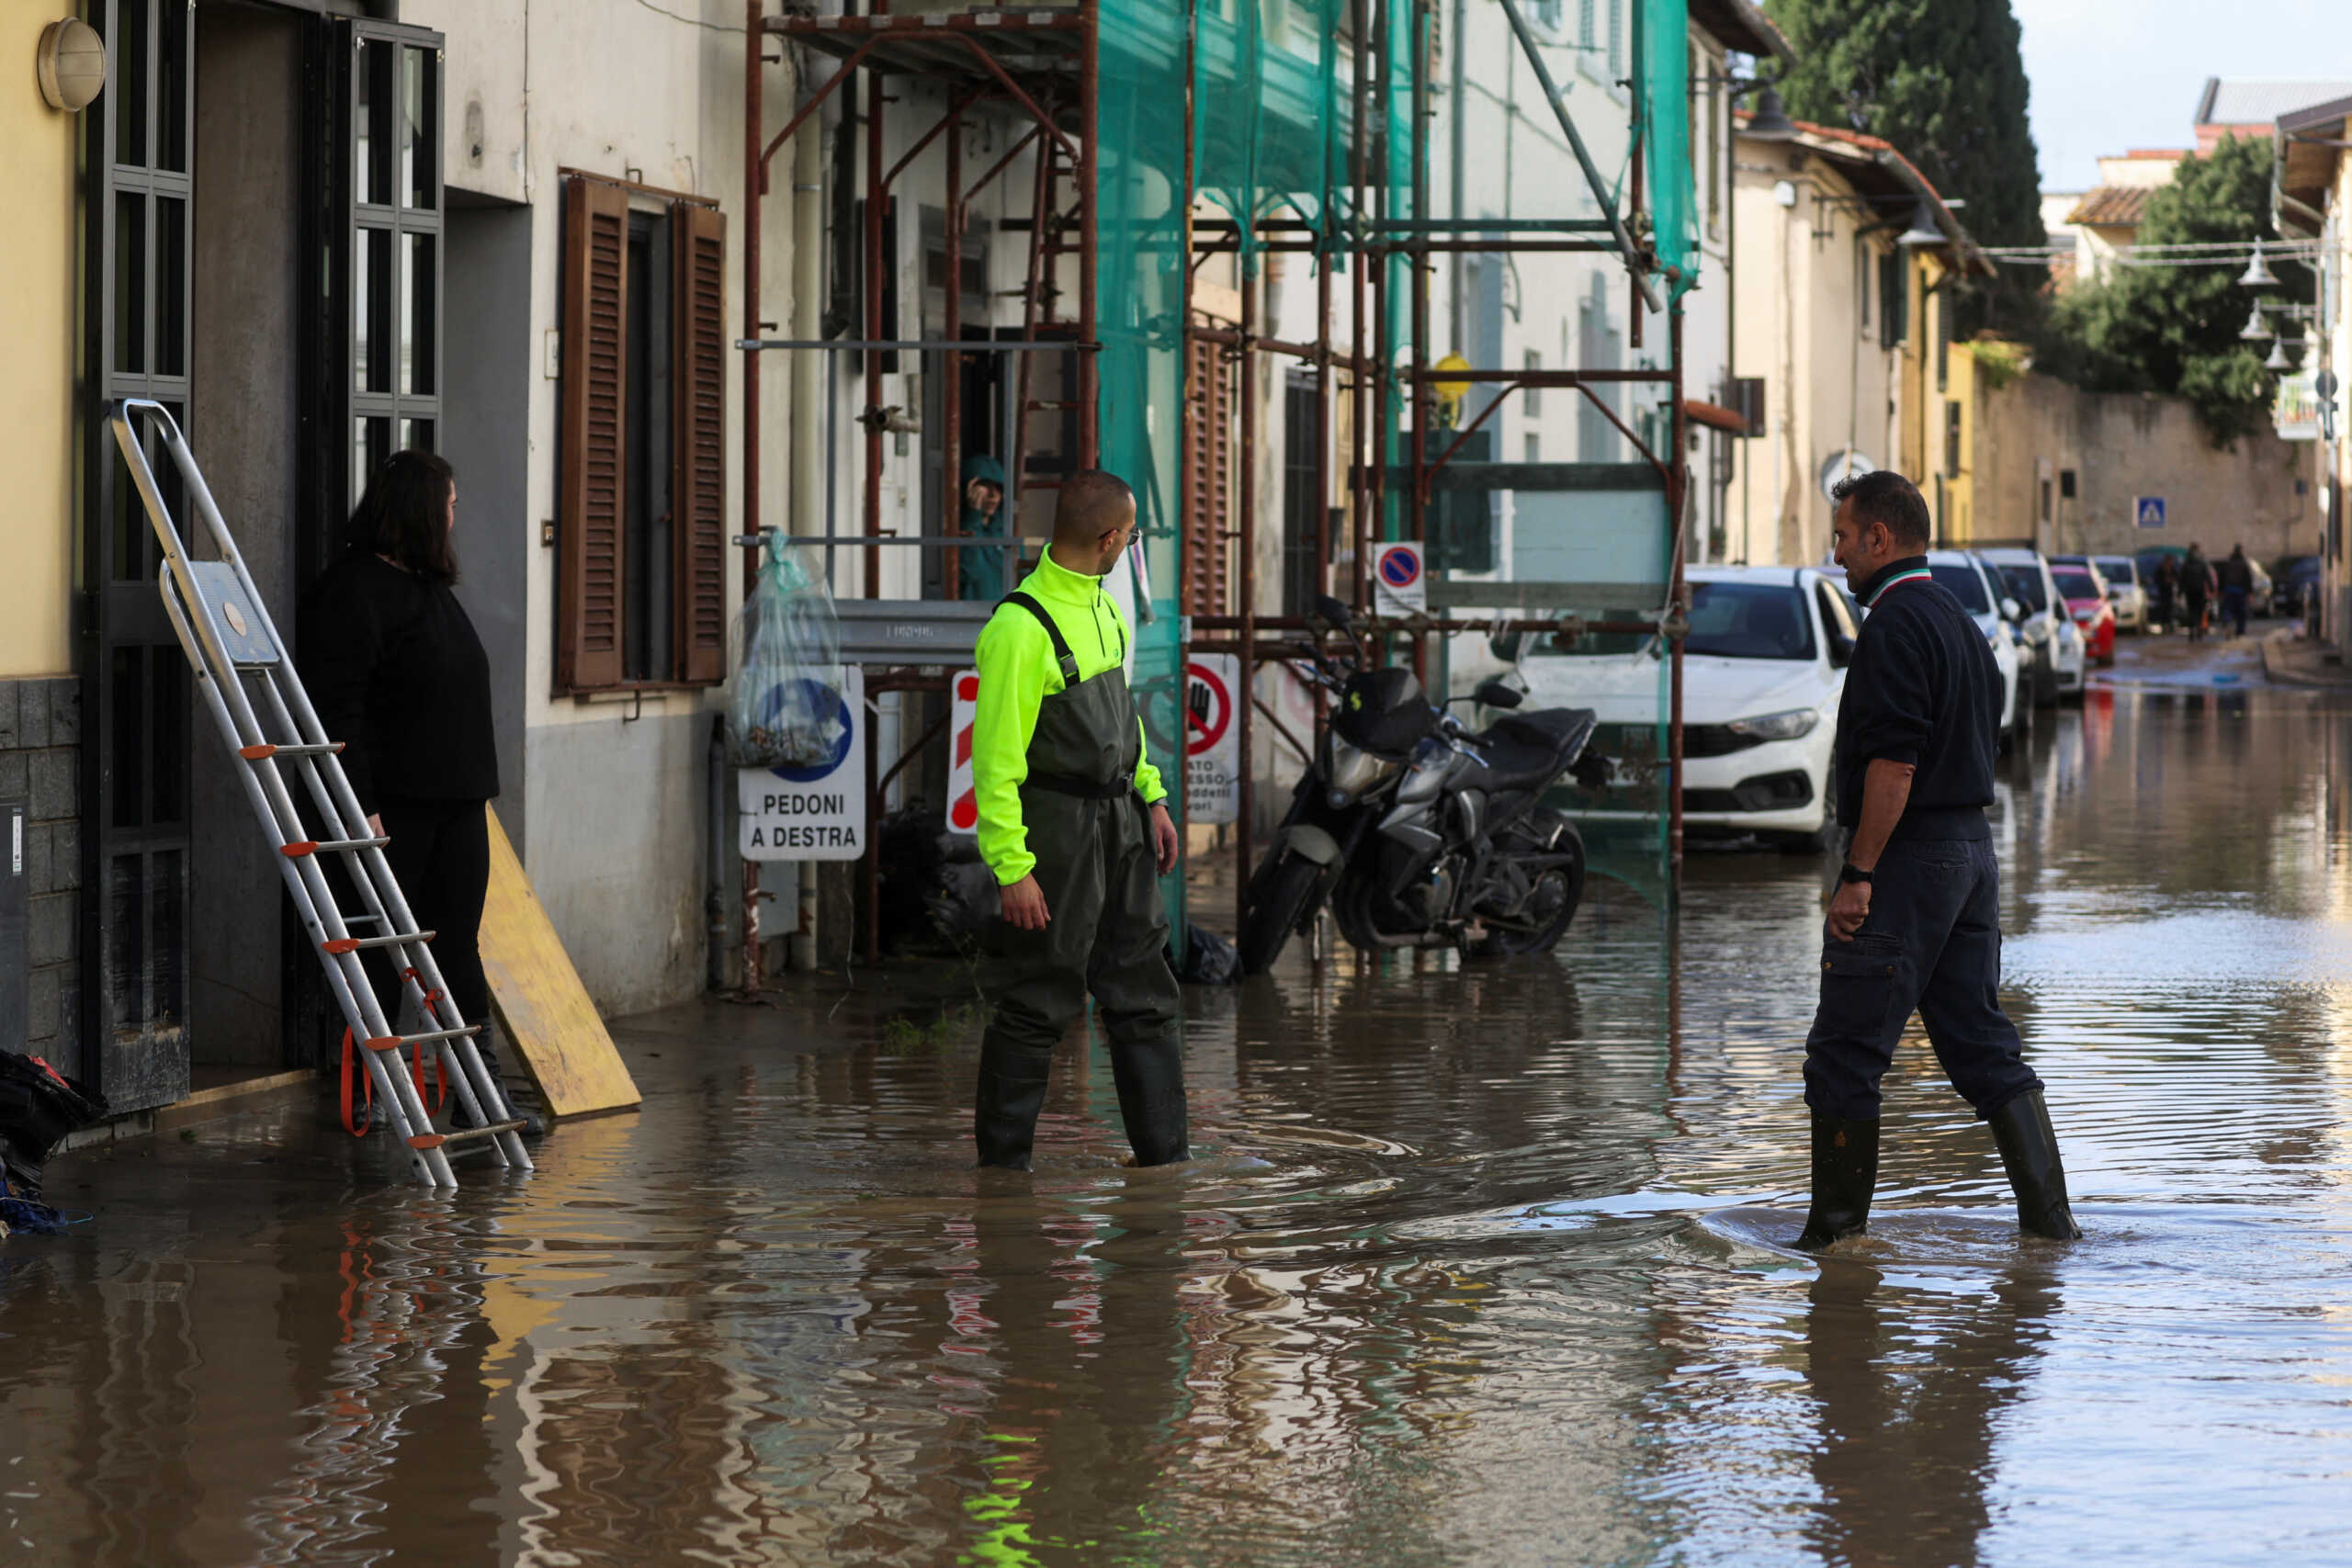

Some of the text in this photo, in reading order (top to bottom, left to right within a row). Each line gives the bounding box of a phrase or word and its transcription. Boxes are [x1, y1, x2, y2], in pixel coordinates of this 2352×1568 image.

[1188, 761, 1214, 772] ATO
[1188, 773, 1226, 785] ESSO
[763, 794, 844, 815] PEDONI
[751, 827, 856, 847] A DESTRA
